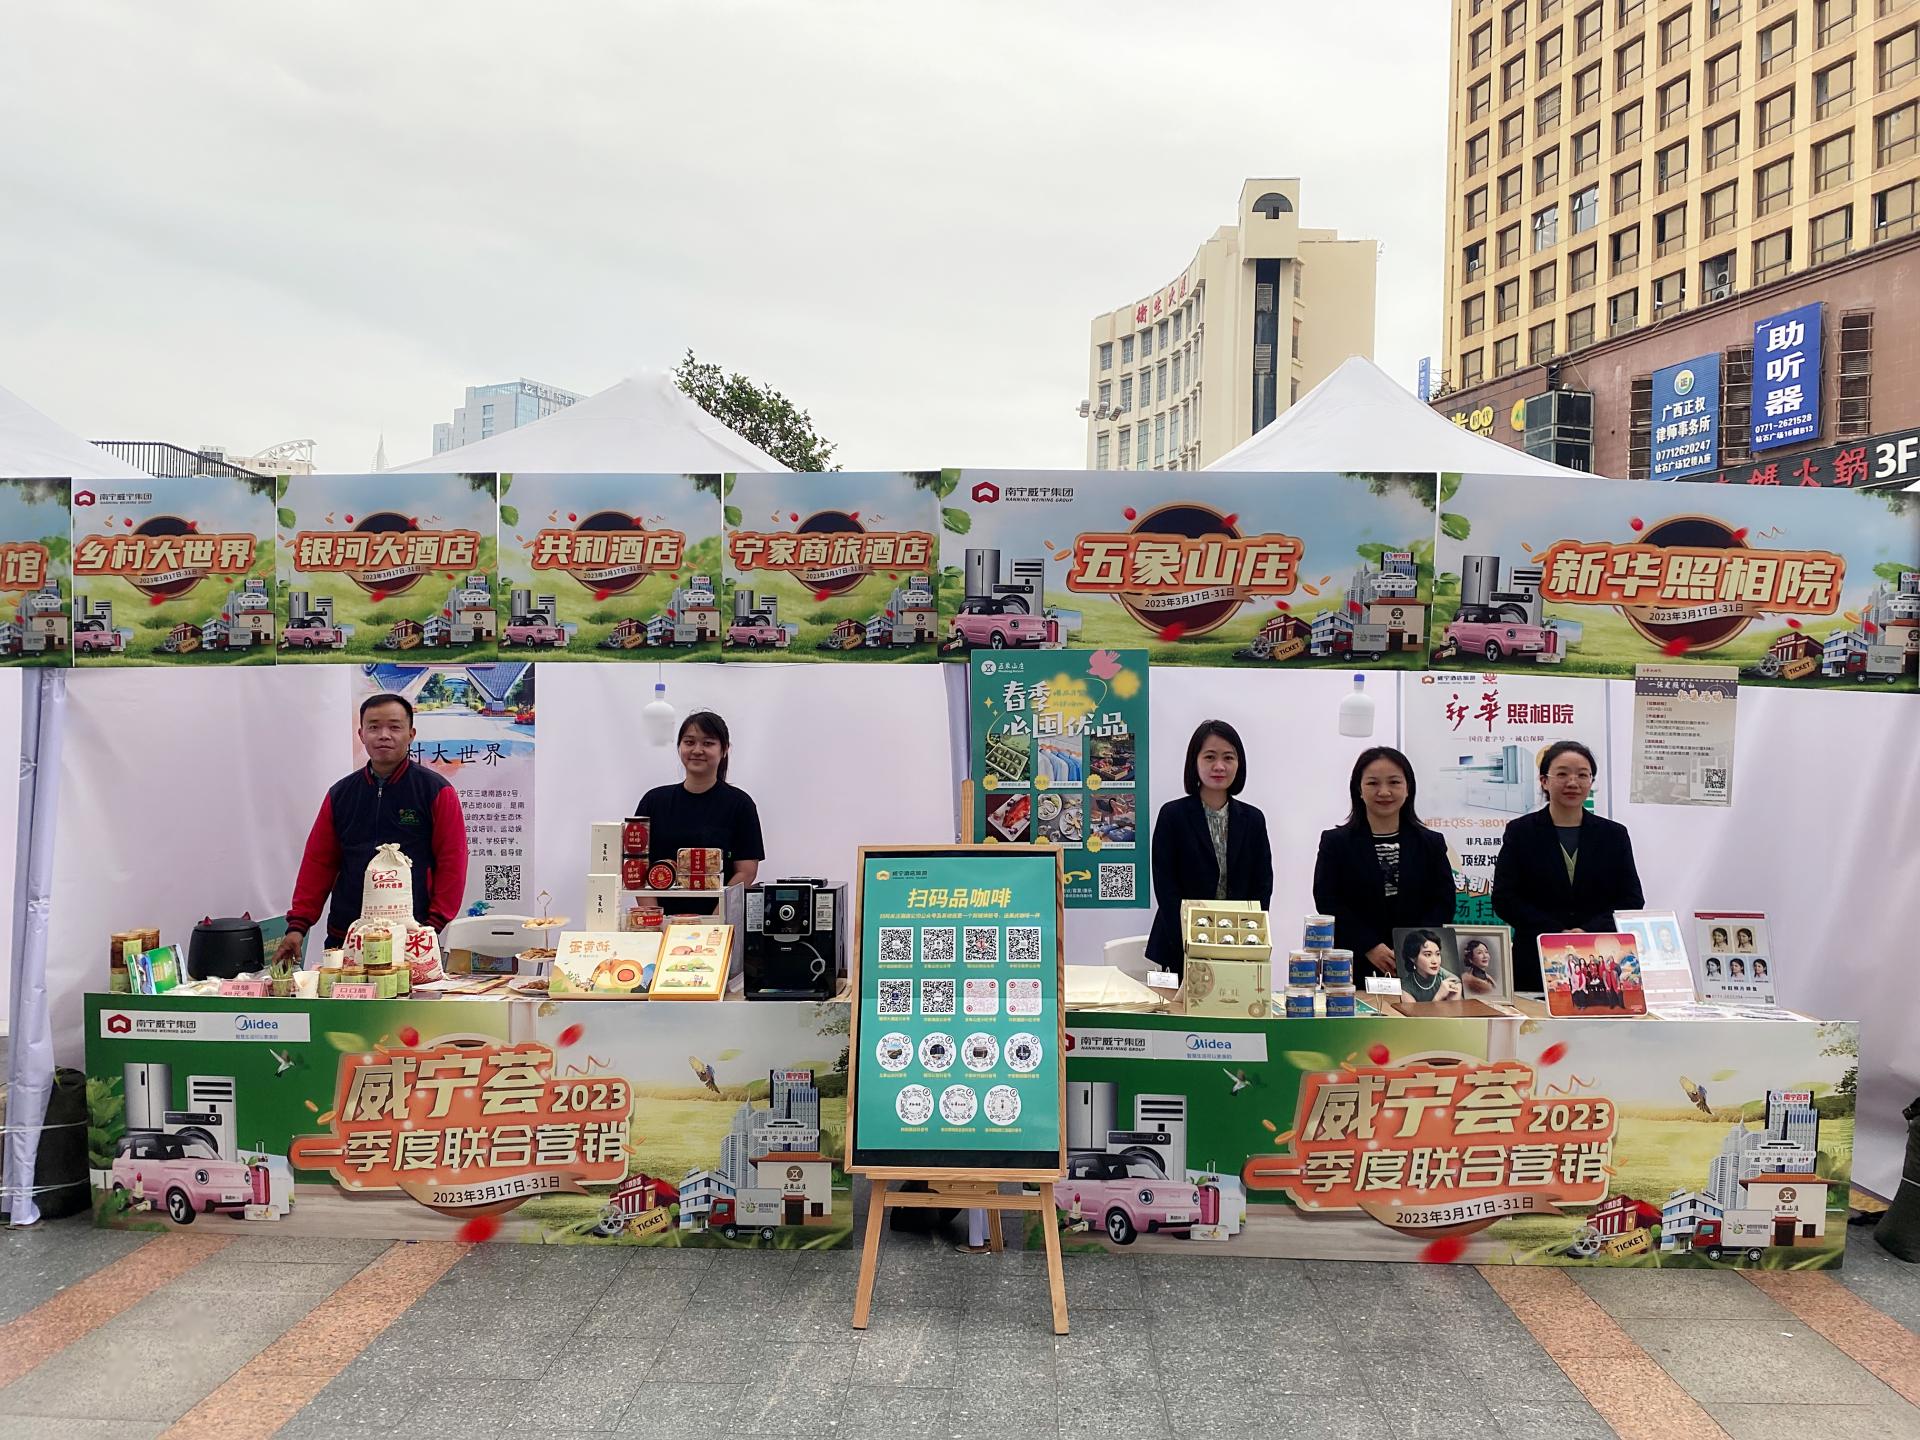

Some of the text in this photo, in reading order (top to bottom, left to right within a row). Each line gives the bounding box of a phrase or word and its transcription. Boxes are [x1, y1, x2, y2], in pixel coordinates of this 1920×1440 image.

[1765, 320, 1805, 417] 助听器
[1662, 396, 1706, 422] 广西正权
[1656, 415, 1711, 444] 律师事务所
[1755, 413, 1812, 434] 0771-2621528
[1656, 439, 1711, 461] 07712620247
[1875, 436, 1919, 478] 3F
[1005, 487, 1074, 498] 南宁威宁集团
[77, 540, 250, 569] 乡村大世界
[299, 535, 475, 567] 银河大酒店
[537, 535, 679, 565] 共和酒店
[733, 536, 929, 566] 宁家商旅酒店
[0, 550, 42, 584] 馆
[362, 565, 422, 580] 2023年3月17日-31日
[583, 564, 643, 579] 2023年3月17日-31日
[806, 565, 864, 580] 2023年3月17日-31日
[1074, 541, 1293, 586] 五象山庄
[139, 569, 199, 584] 2023年3月17日-31日
[1548, 550, 1837, 606] 新华照相院
[1145, 586, 1235, 608] 2023年3月17日-31日
[1649, 603, 1744, 622] 2023年3月17日-31日
[1003, 680, 1051, 712] 春季
[1003, 711, 1128, 740] 必囤优品
[407, 743, 506, 767] 村大世界
[457, 789, 522, 798] 宁区三塘南路82号，
[1466, 837, 1502, 846] 非凡品质
[907, 887, 1012, 908] 扫码品咖啡
[136, 1019, 196, 1029] 南宁威宁集团
[235, 1014, 279, 1031] Midea
[1080, 1037, 1146, 1047] 南宁威宁集团
[1186, 1033, 1232, 1050] Midea
[342, 1051, 626, 1121] 威宁荟 2023
[1301, 1069, 1610, 1141] 威宁荟 2023
[300, 1118, 628, 1173] 一季度联合营销
[1254, 1141, 1608, 1193] 一季度联合营销
[433, 1175, 561, 1203] 2023年3月17日-31日
[636, 1213, 665, 1232] TICKET
[1396, 1196, 1535, 1225] 2023年3月17日-31日
[1614, 1233, 1645, 1253] TICKET
